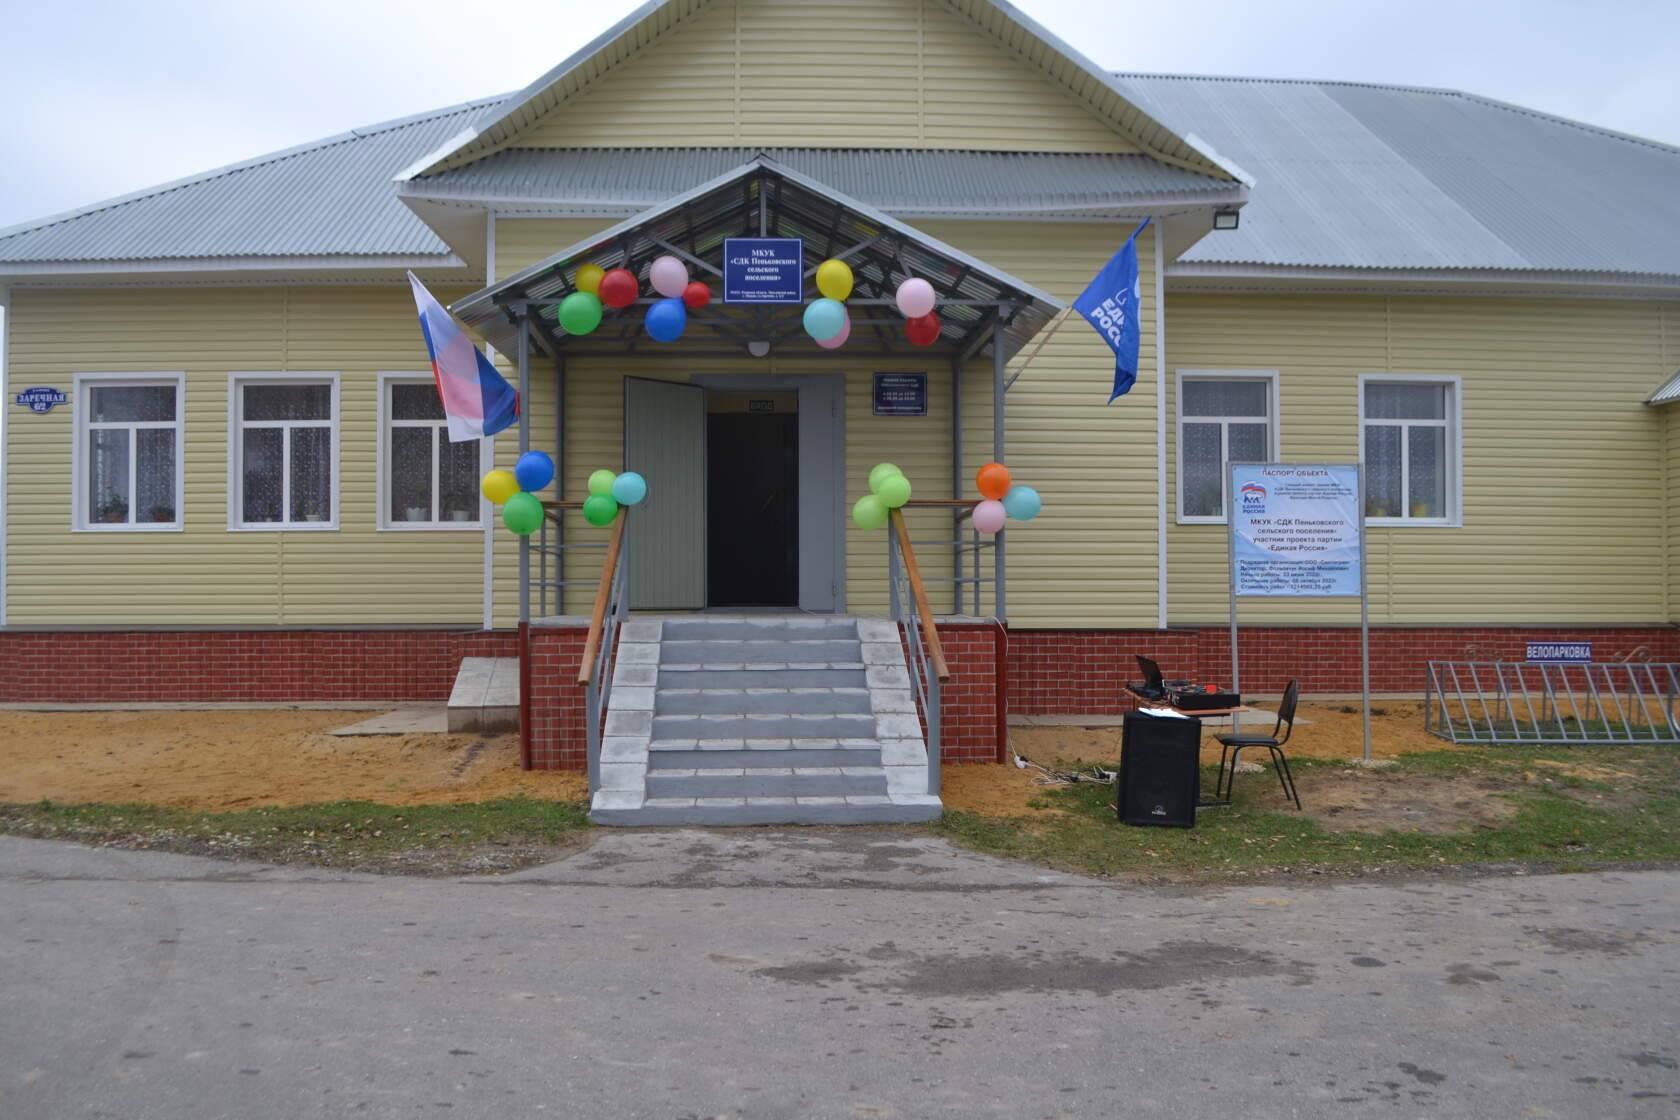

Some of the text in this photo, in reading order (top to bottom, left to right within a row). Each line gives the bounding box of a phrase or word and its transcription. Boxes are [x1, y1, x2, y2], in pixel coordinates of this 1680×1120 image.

[752, 249, 775, 257] МКУК
[19, 393, 65, 402] ЗАРЕЧНАЯ
[1527, 645, 1591, 658] ВЕЛОПАРКОВКА
